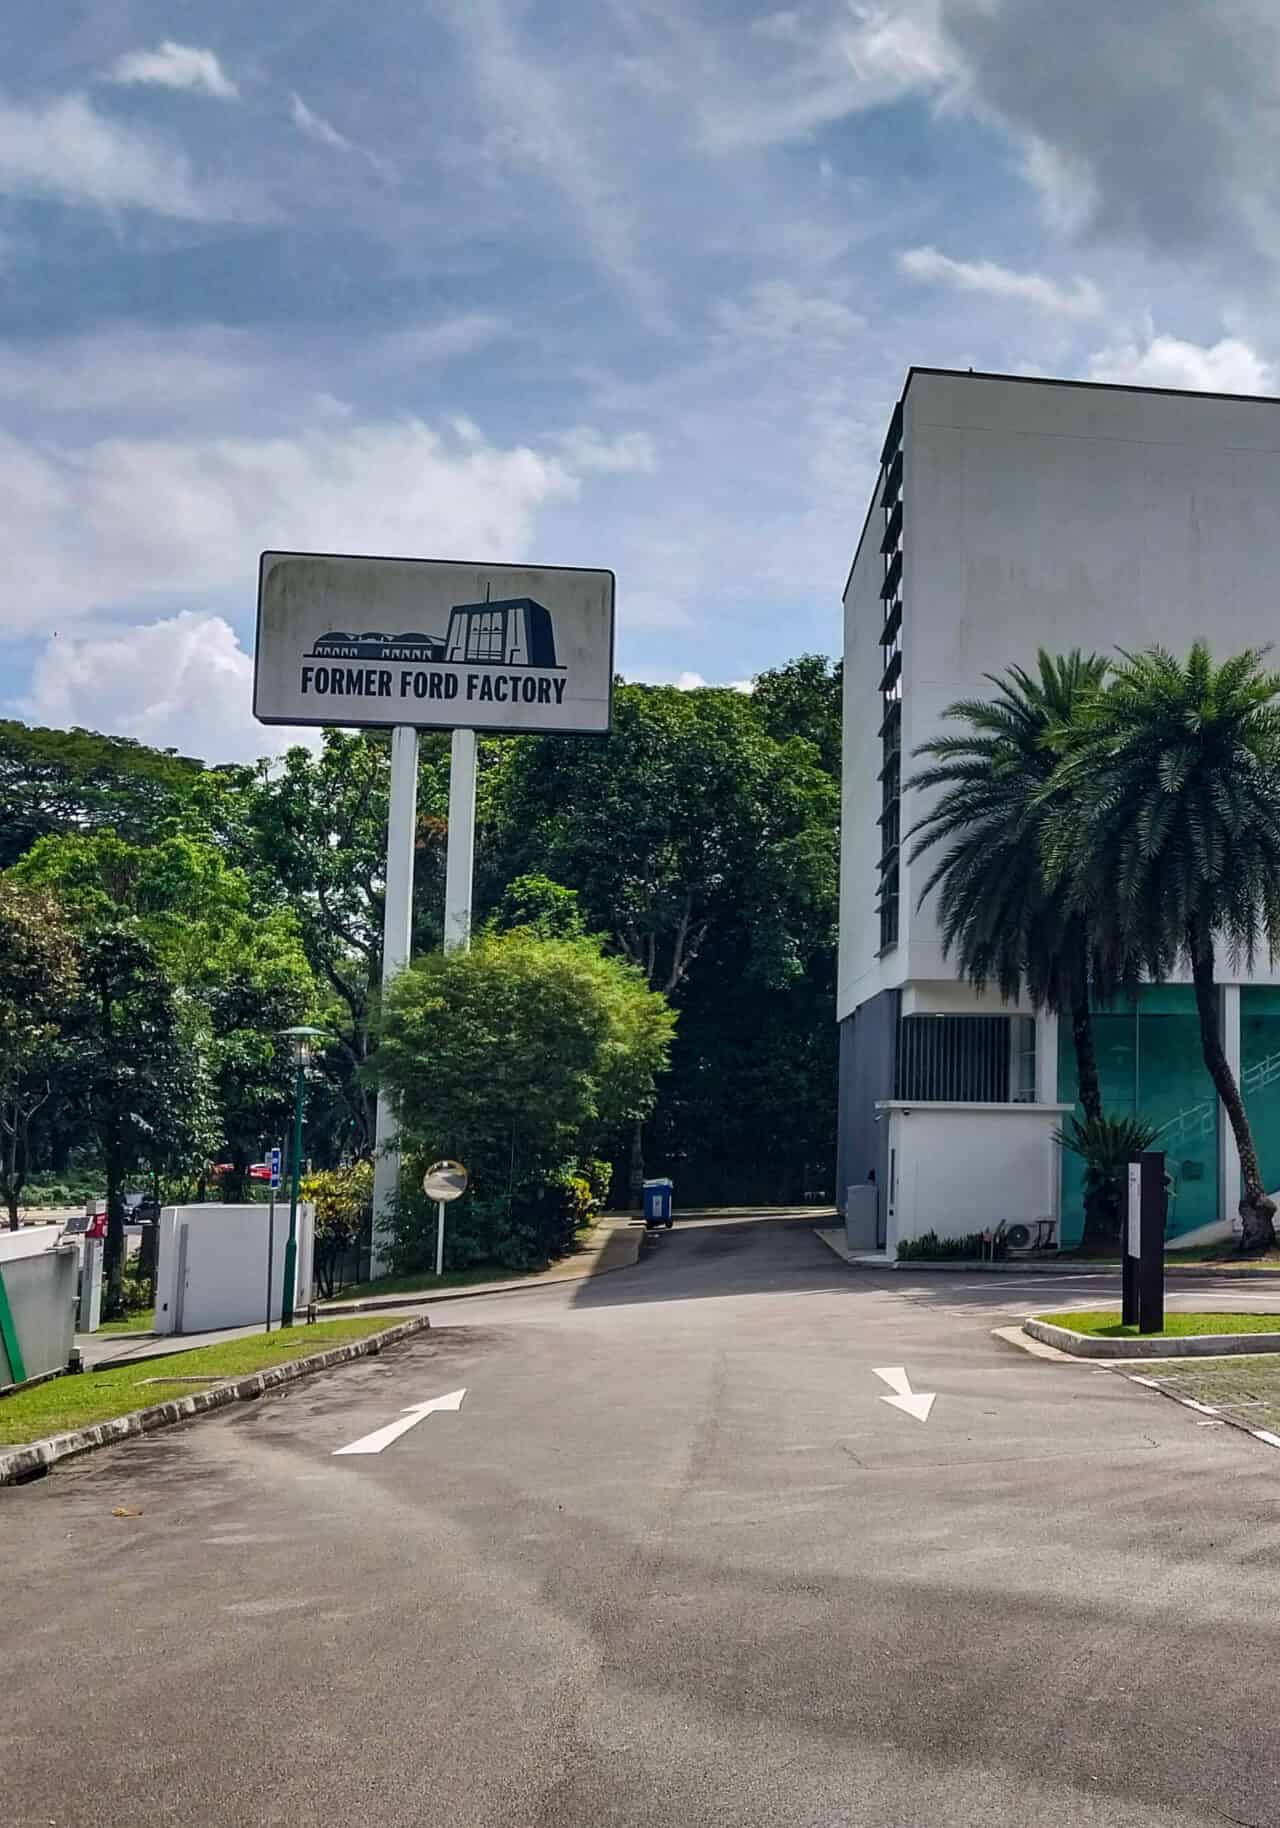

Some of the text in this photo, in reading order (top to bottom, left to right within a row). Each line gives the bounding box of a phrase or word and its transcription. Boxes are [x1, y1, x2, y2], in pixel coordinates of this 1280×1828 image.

[301, 666, 568, 704] FORMER FORD FACTORY
